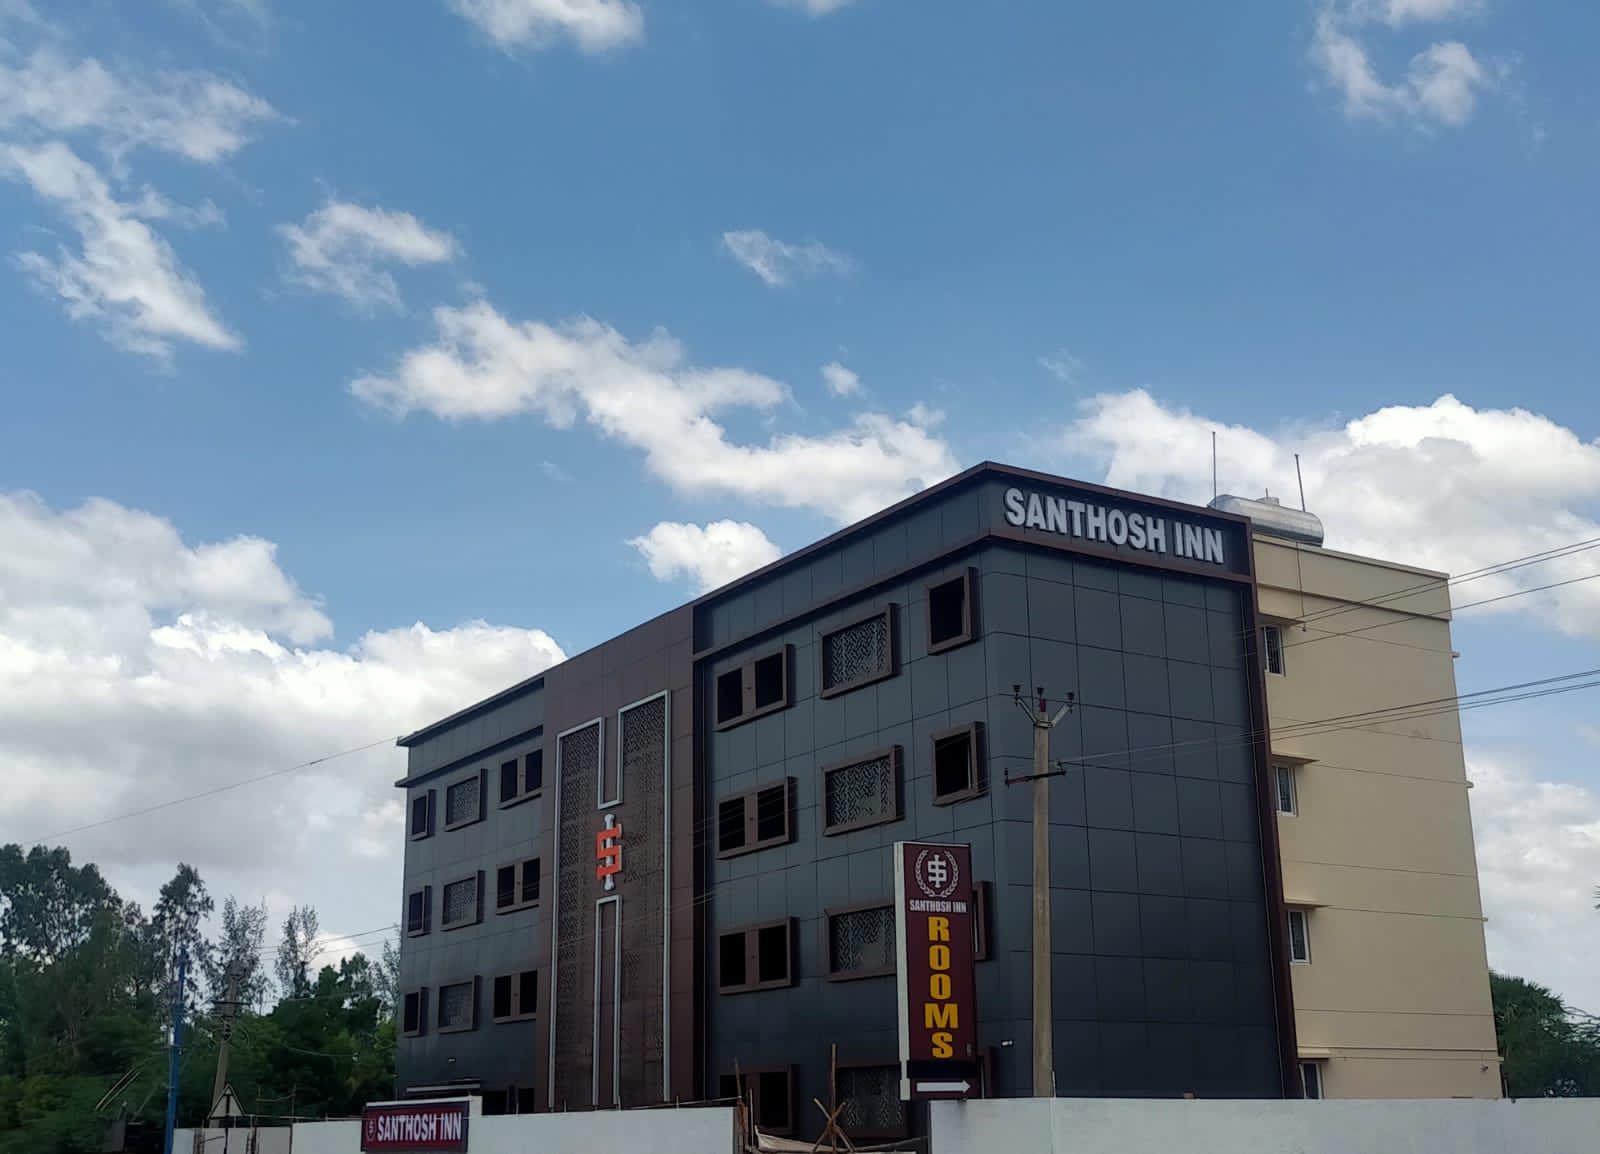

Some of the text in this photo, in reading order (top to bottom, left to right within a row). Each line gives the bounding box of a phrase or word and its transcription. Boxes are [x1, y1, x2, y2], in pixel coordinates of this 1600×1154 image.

[1005, 487, 1224, 564] SANTHOSH INN
[909, 899, 967, 913] SANTHOSH INN
[924, 916, 960, 1059] ROOMS
[377, 1114, 437, 1142] SANTHOSH
[440, 1112, 462, 1140] INN
